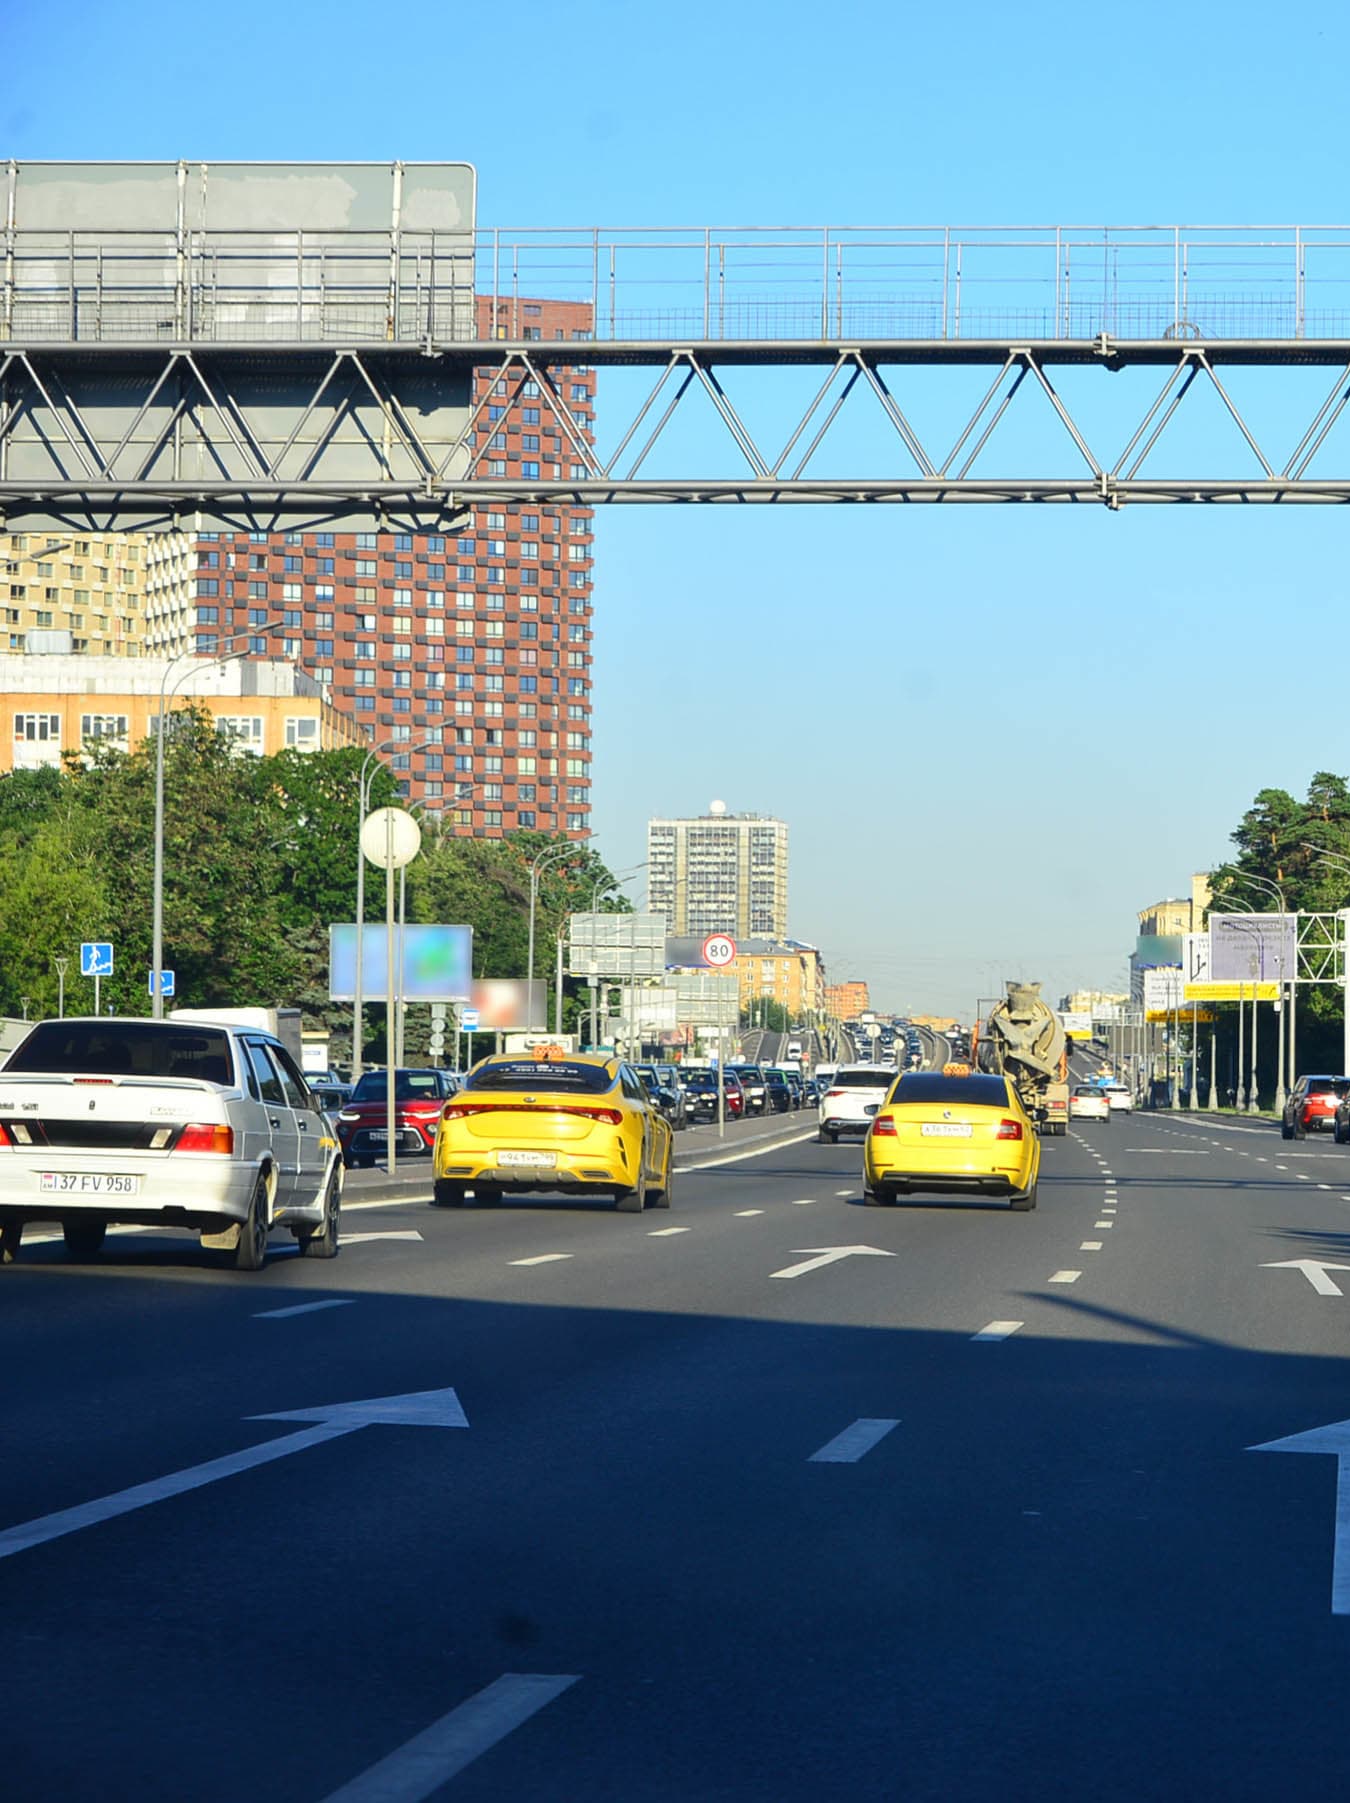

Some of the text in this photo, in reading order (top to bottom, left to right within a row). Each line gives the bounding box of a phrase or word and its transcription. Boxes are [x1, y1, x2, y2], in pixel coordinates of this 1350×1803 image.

[710, 944, 729, 957] 80
[60, 1175, 132, 1192] 37 FV 958
